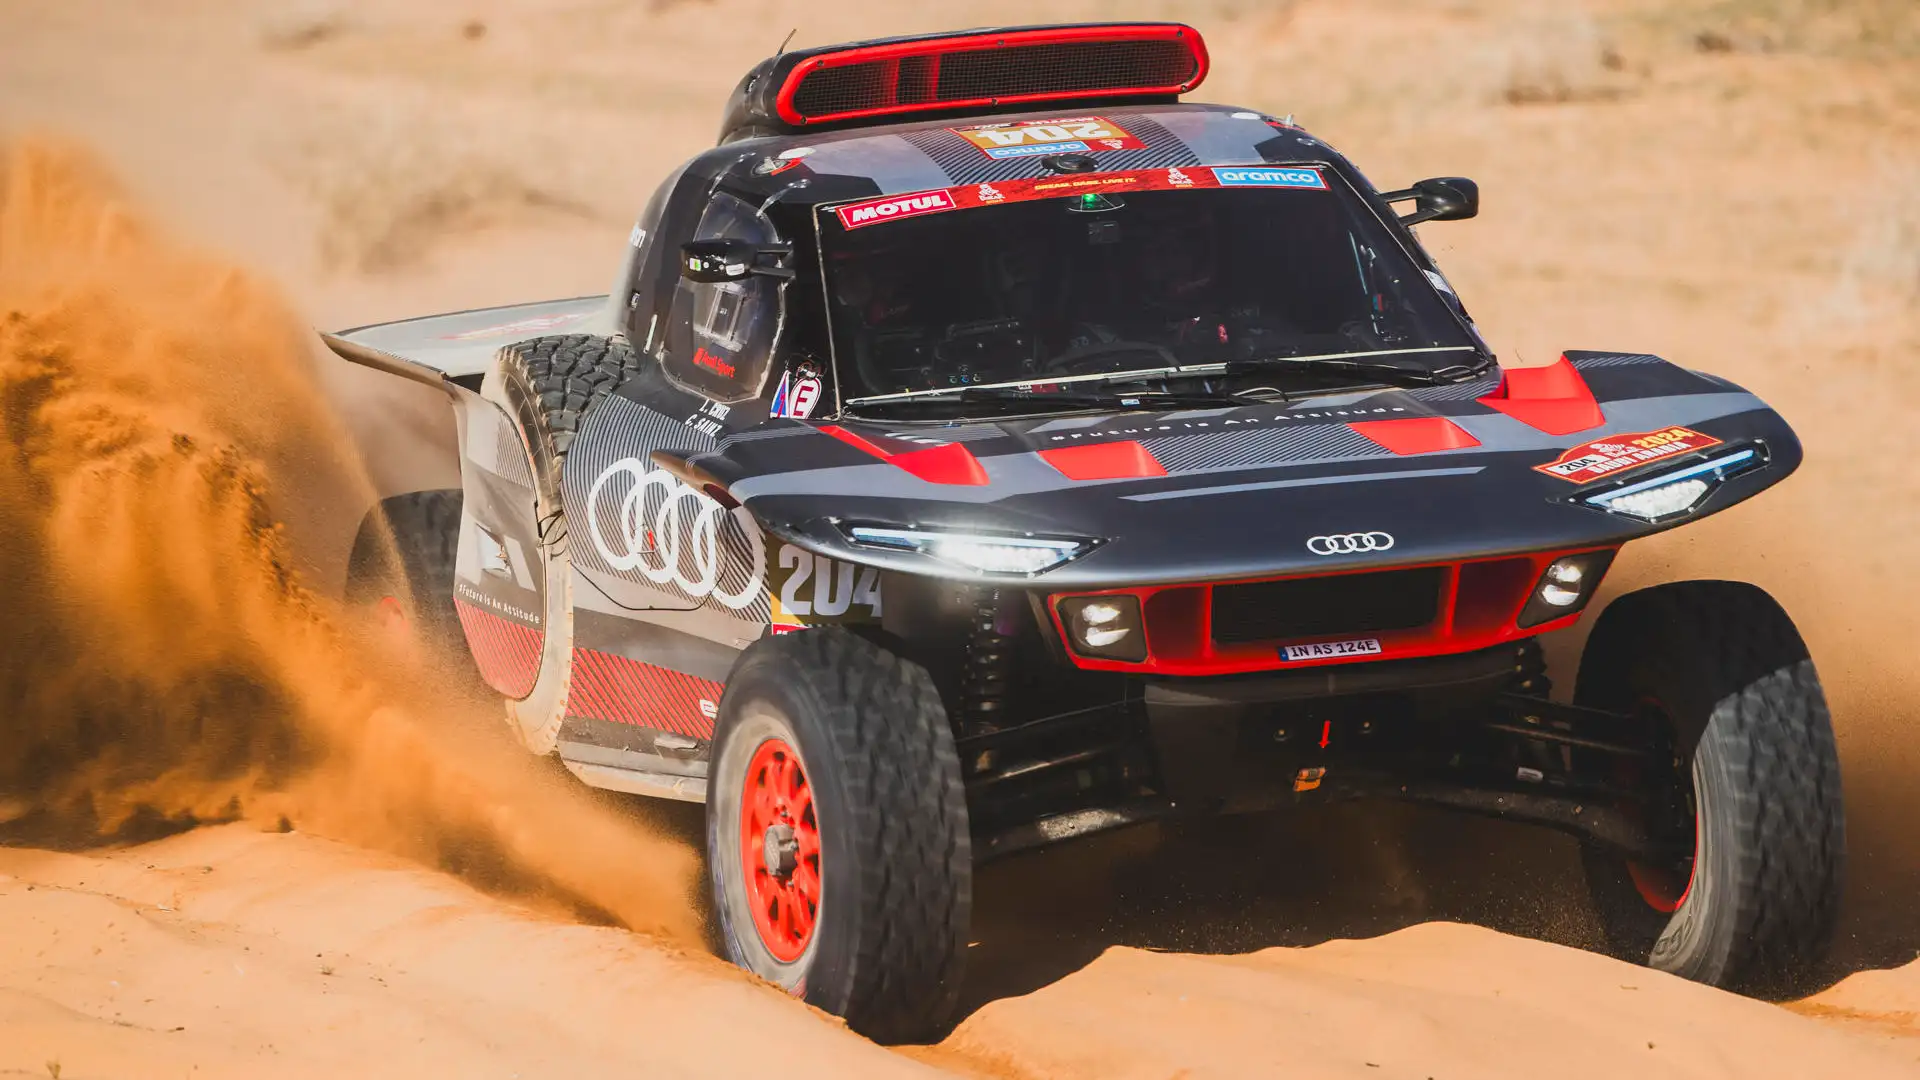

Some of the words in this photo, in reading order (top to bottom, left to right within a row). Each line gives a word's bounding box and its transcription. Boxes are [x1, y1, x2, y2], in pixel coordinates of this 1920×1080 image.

[976, 122, 1112, 145] 204
[995, 144, 1081, 157] aramco
[1222, 170, 1316, 183] aramco
[851, 194, 948, 223] MOTUL
[793, 385, 814, 416] E
[1631, 428, 1695, 449] 2024
[1558, 458, 1598, 472] 204
[778, 543, 883, 618] 204
[458, 583, 483, 603] #Future
[492, 597, 502, 610] An
[503, 602, 540, 624] Attitude
[1291, 646, 1310, 657] IN
[1313, 644, 1333, 655] AS
[1336, 640, 1377, 653] 124E
